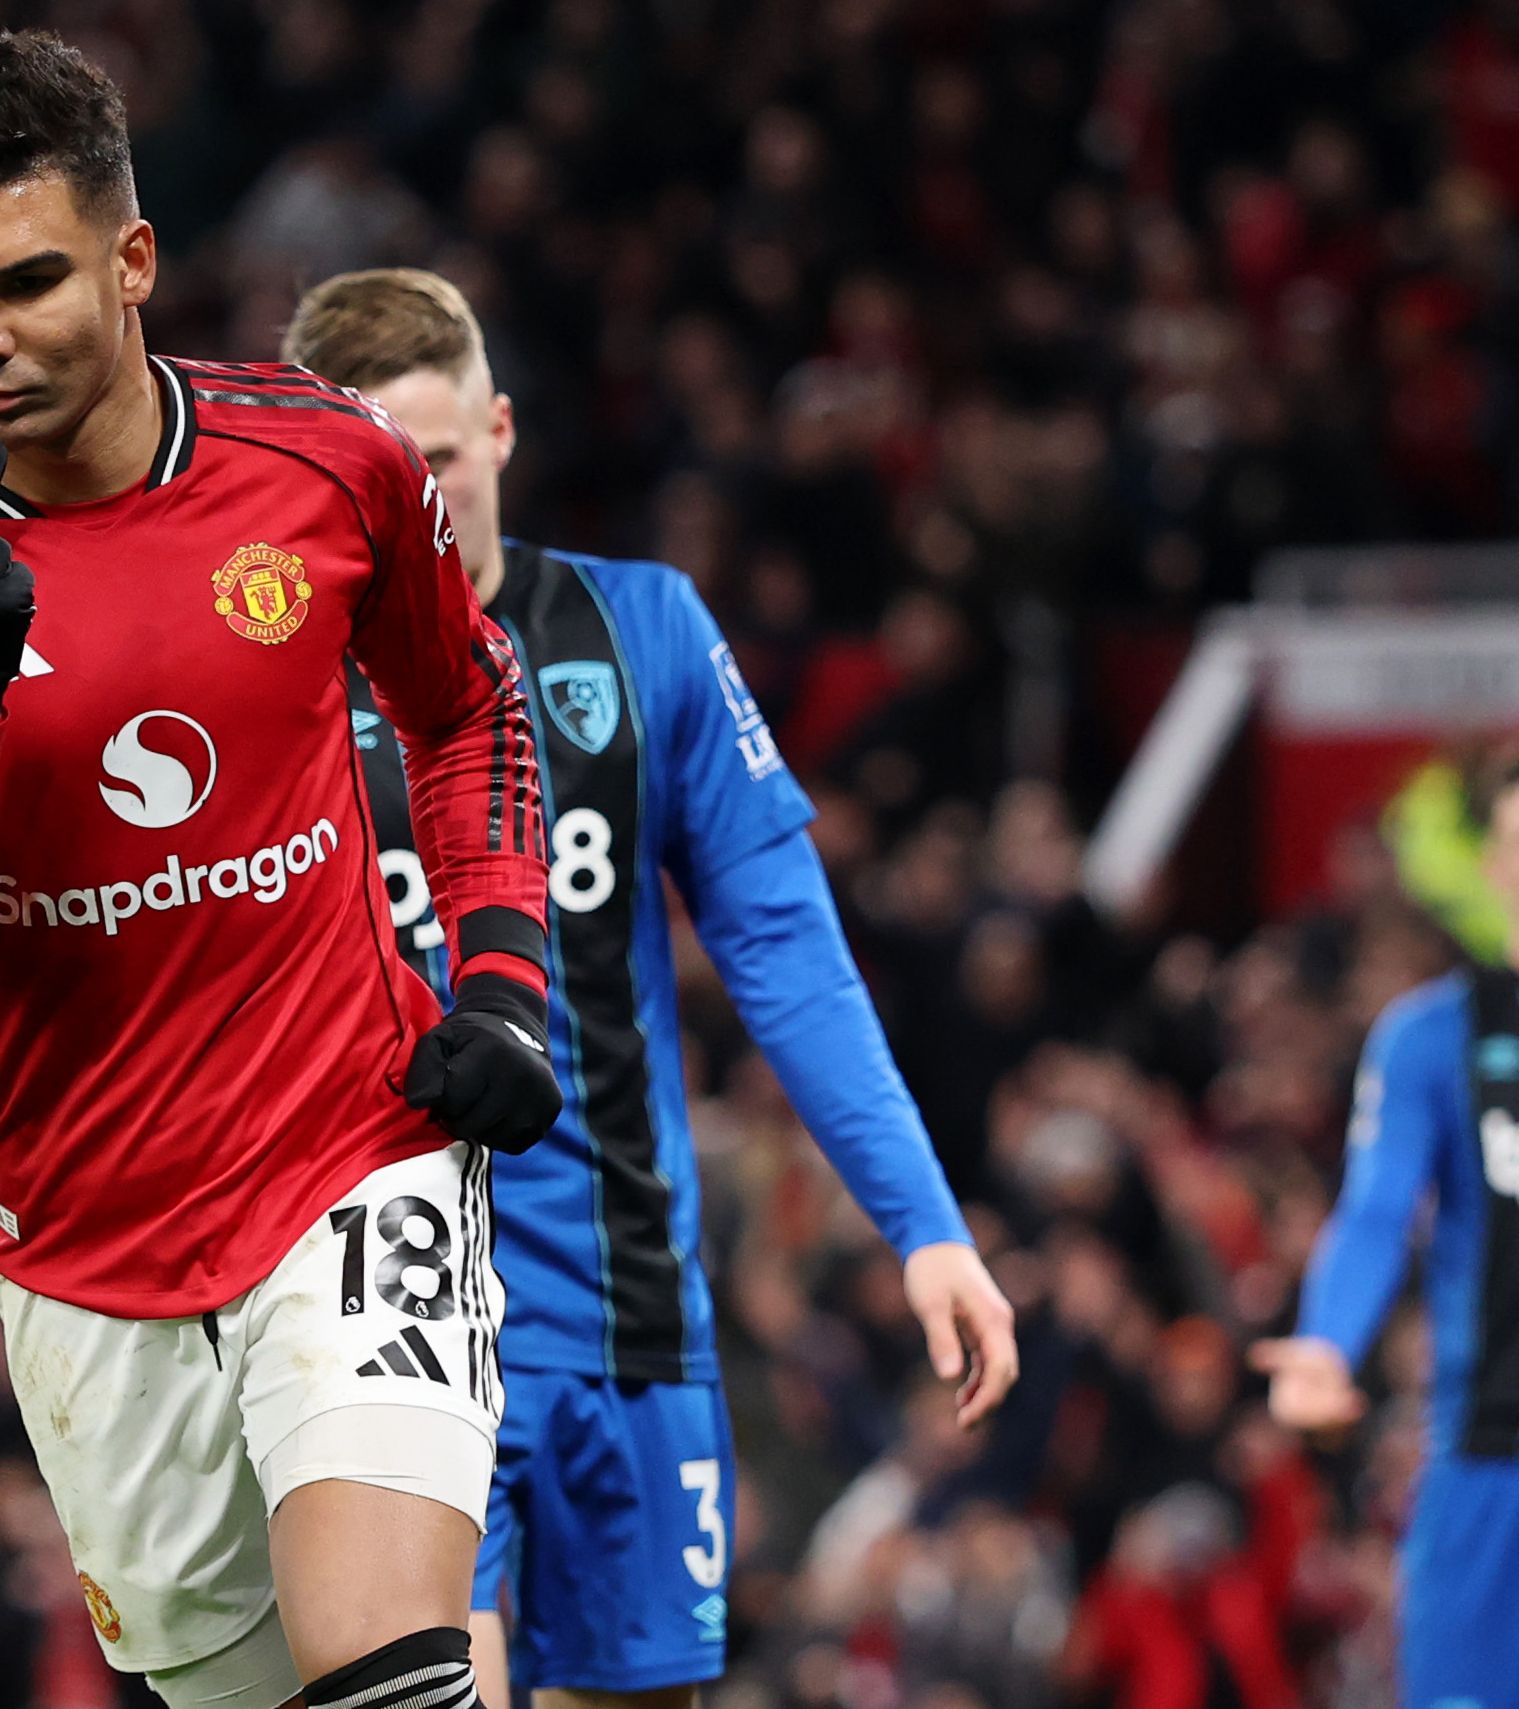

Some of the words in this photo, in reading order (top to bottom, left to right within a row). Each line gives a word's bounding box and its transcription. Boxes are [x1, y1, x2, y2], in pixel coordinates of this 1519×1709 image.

[220, 550, 298, 589] MANCHESTER
[245, 616, 298, 637] UNITED
[328, 1195, 456, 1321] 18
[679, 1457, 727, 1589] 3
